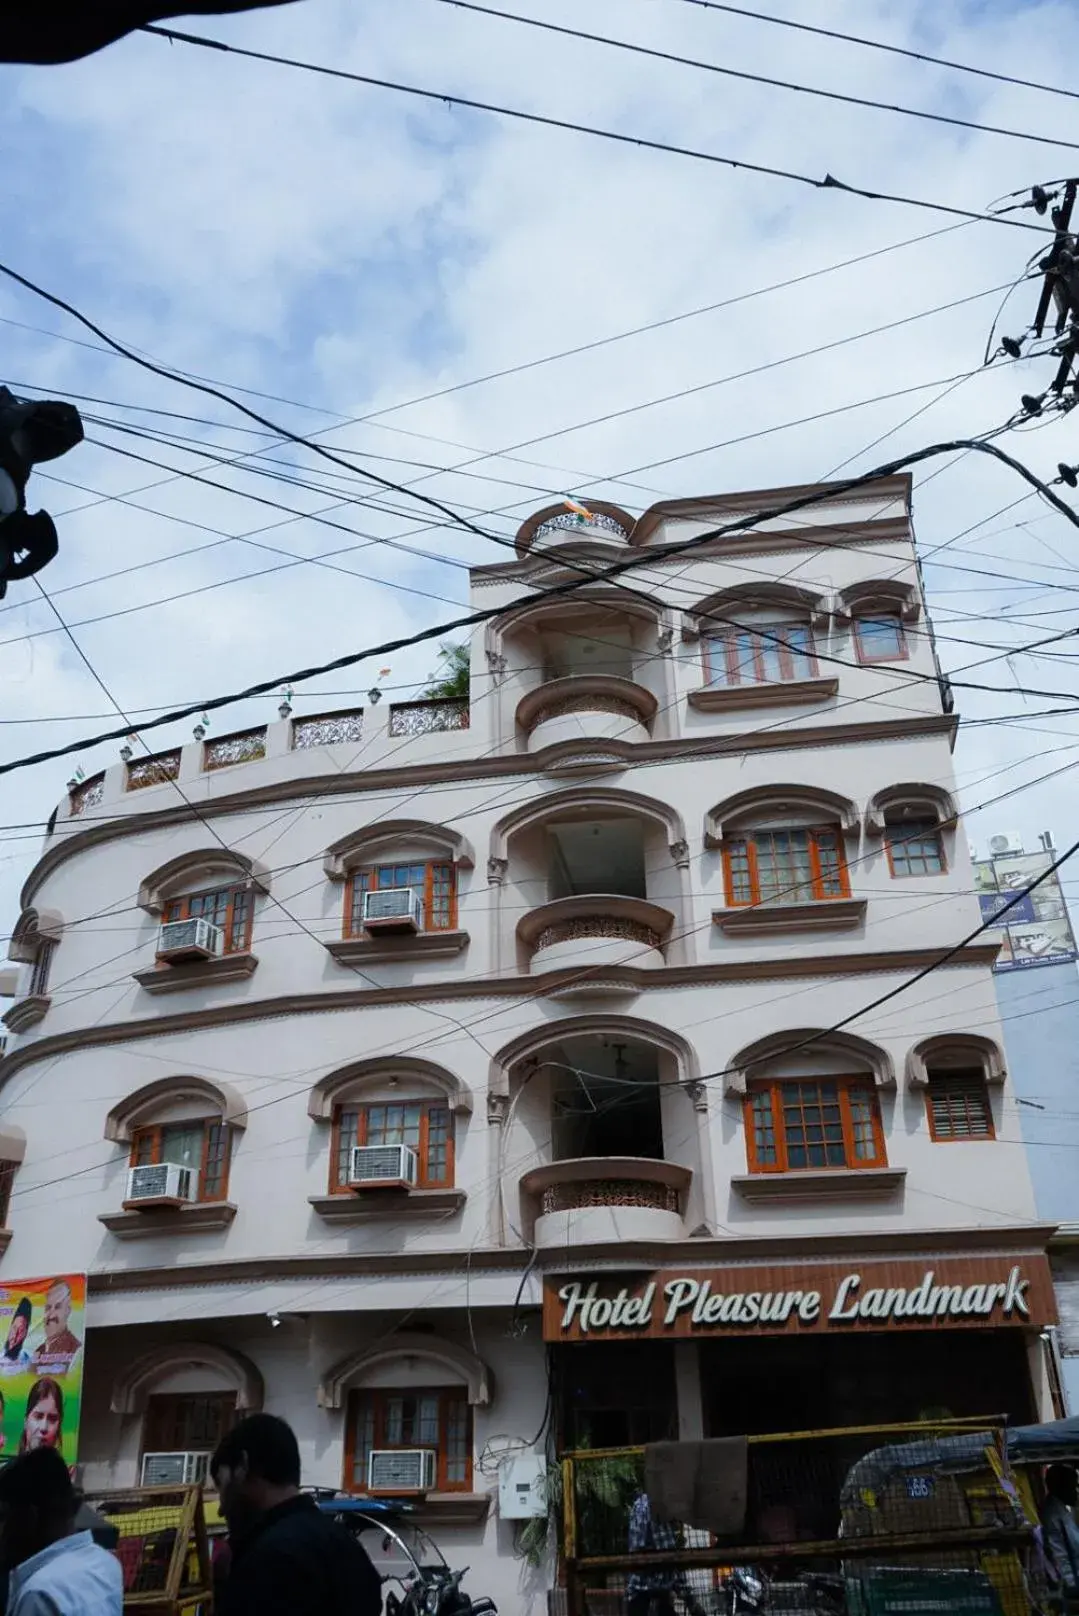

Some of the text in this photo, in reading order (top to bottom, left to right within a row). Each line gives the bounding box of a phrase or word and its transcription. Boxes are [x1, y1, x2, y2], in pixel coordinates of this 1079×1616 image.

[559, 1265, 1030, 1332] Hotel Pleasure Landmark
